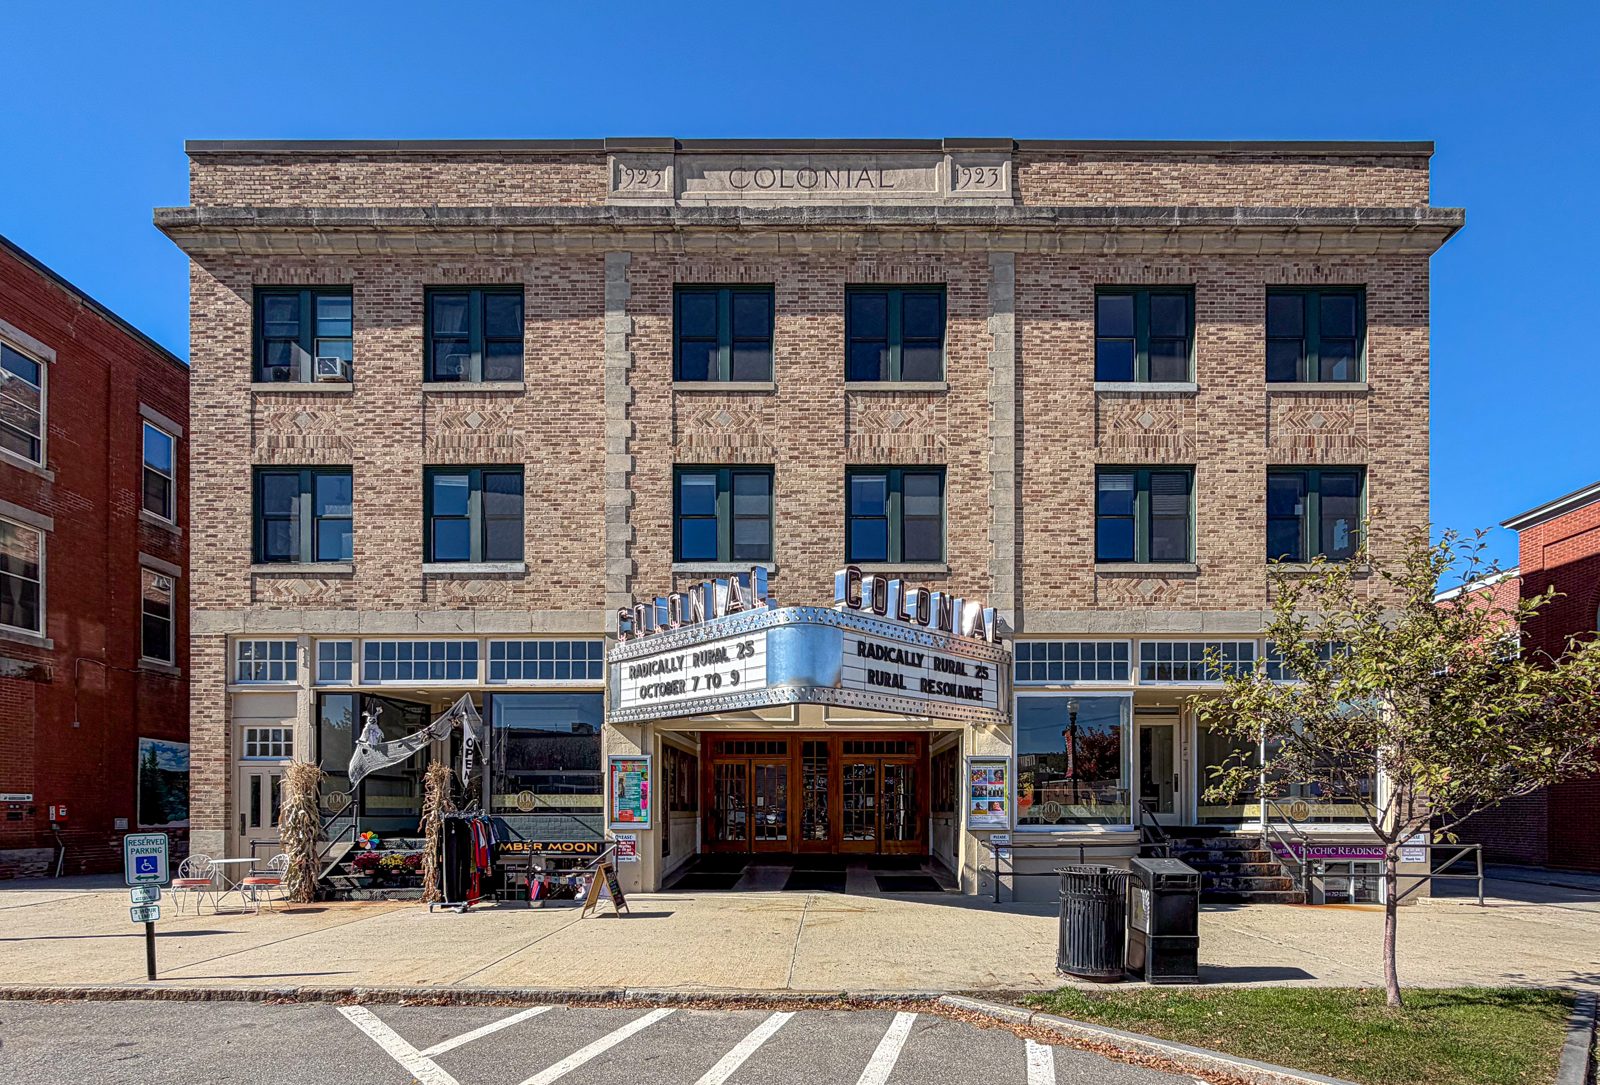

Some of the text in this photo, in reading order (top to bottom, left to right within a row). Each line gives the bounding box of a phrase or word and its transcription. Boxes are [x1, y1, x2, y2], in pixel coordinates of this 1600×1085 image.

[618, 166, 662, 189] 1923
[728, 166, 895, 189] COLONIAL
[955, 166, 999, 189] 1923
[616, 565, 772, 642] COLONIAL
[837, 565, 1003, 645] COLONIAL
[628, 640, 755, 680] RADICALLY RURAL 25
[857, 640, 989, 680] RADICALLY RURAL 25
[639, 670, 740, 700] OCTOBER 7 TO 9
[867, 668, 907, 690] RURAL
[464, 737, 474, 780] OPEN
[128, 838, 165, 847] RESERVED
[130, 847, 162, 855] PARKING
[498, 842, 598, 853] MBER MOON
[1298, 846, 1336, 855] PYCHIC
[1338, 846, 1384, 855] READINGS
